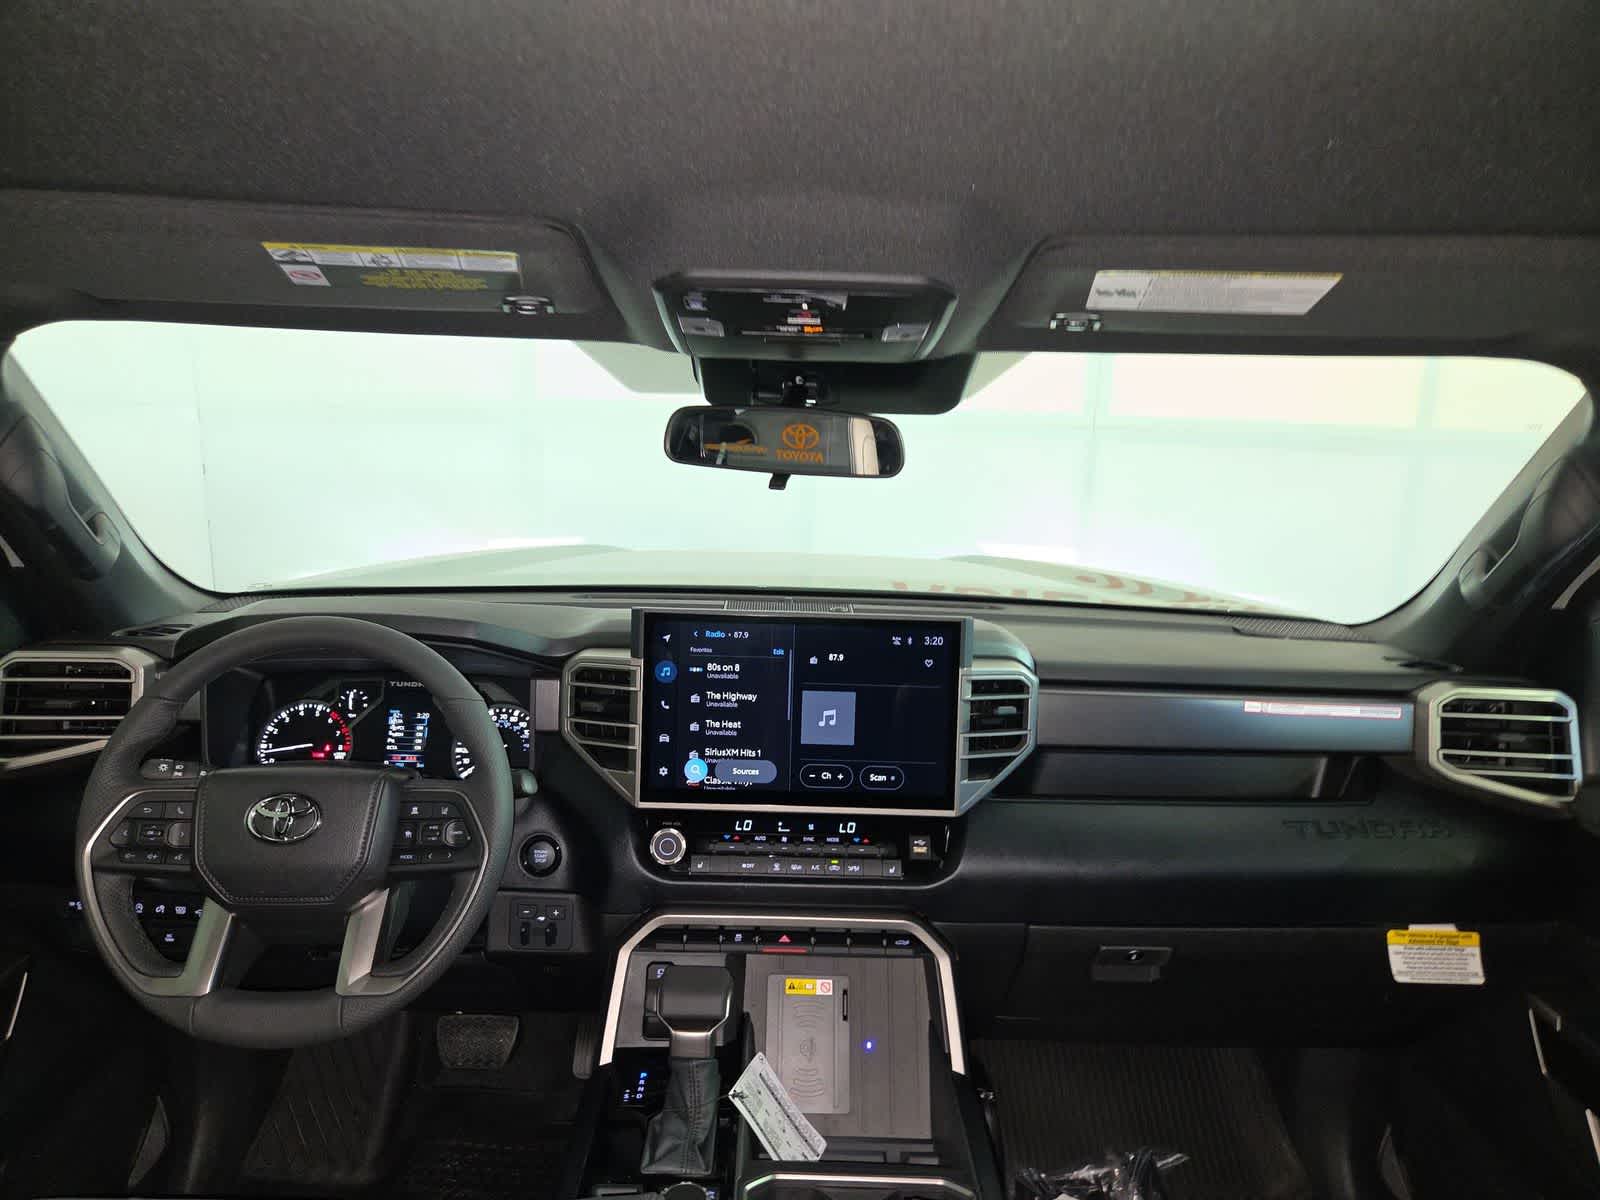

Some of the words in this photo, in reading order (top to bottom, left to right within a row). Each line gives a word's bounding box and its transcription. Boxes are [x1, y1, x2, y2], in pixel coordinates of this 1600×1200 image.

[705, 630, 726, 638] Radio
[733, 631, 749, 639] 87.9
[924, 636, 944, 646] 3:20
[828, 653, 844, 662] 87.9
[706, 663, 722, 672] 80s
[722, 664, 733, 672] on
[734, 663, 740, 672] 8
[706, 691, 721, 700] The
[722, 692, 758, 702] Highway
[705, 720, 721, 728] The
[721, 720, 742, 729] Heat
[704, 748, 739, 757] SiriusXM
[740, 749, 757, 758] Hits
[732, 767, 760, 776] Sources
[821, 771, 832, 780] Ch
[869, 773, 887, 782] Scan
[1282, 817, 1454, 840] TUNDRA
